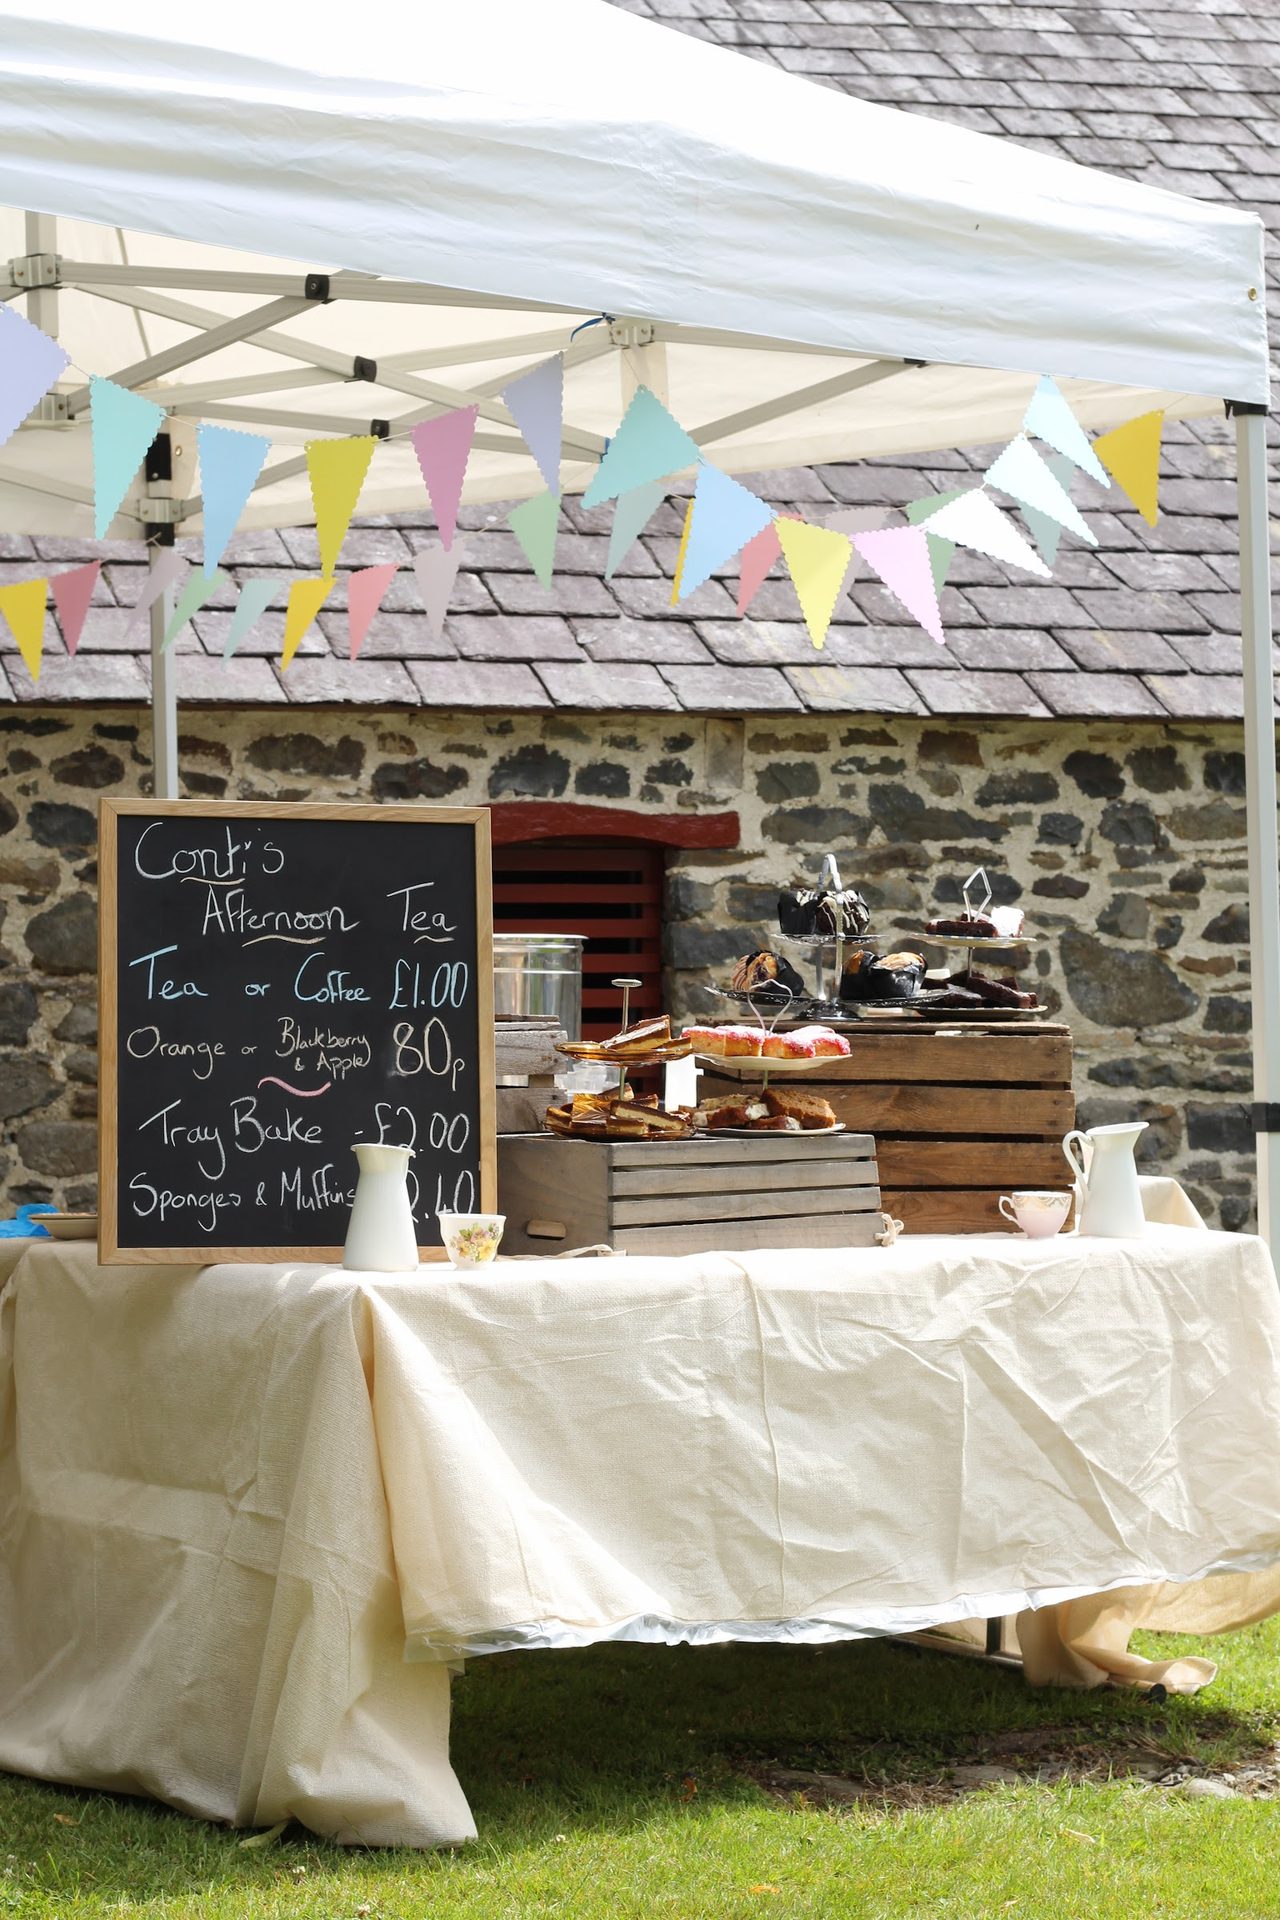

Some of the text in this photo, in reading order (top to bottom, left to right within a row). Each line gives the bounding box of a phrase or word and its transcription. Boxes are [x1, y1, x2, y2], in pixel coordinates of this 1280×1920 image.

[202, 881, 457, 936] Afternoon Tea
[128, 944, 468, 1010] Tea or Coffee £1.00
[126, 1016, 465, 1091] Orange or Blackberry 80p
[294, 1050, 366, 1080] & Apple
[138, 1098, 226, 1180] Tray
[230, 1096, 323, 1153] Bake
[129, 1171, 242, 1232] Sponges
[255, 1181, 268, 1206] &
[280, 1163, 356, 1212] Muffins
